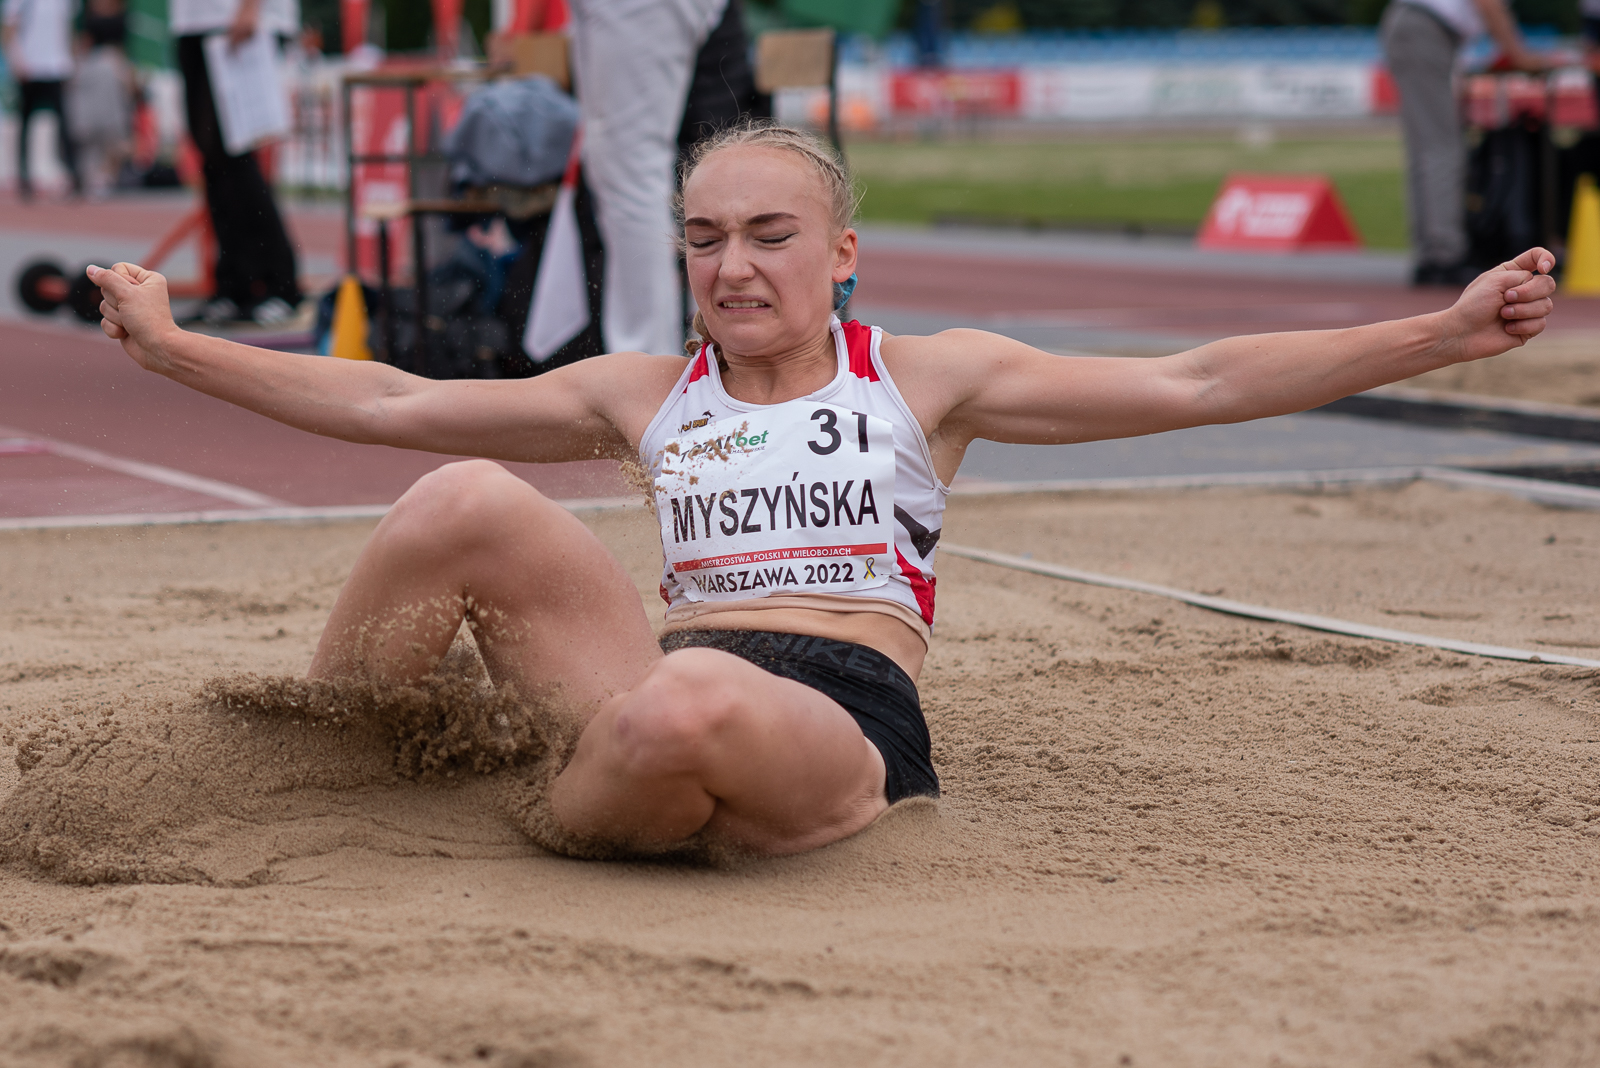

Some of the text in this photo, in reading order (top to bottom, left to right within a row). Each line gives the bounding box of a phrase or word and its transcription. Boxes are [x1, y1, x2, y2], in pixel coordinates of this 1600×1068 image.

[807, 408, 869, 455] 31
[670, 471, 880, 543] MYSZYŃSKA
[691, 563, 855, 593] WARSZAWA 2022
[701, 548, 852, 568] MISTRZOSTWA POLSKI W WIELOBOJACH
[748, 631, 881, 676] NIKE
